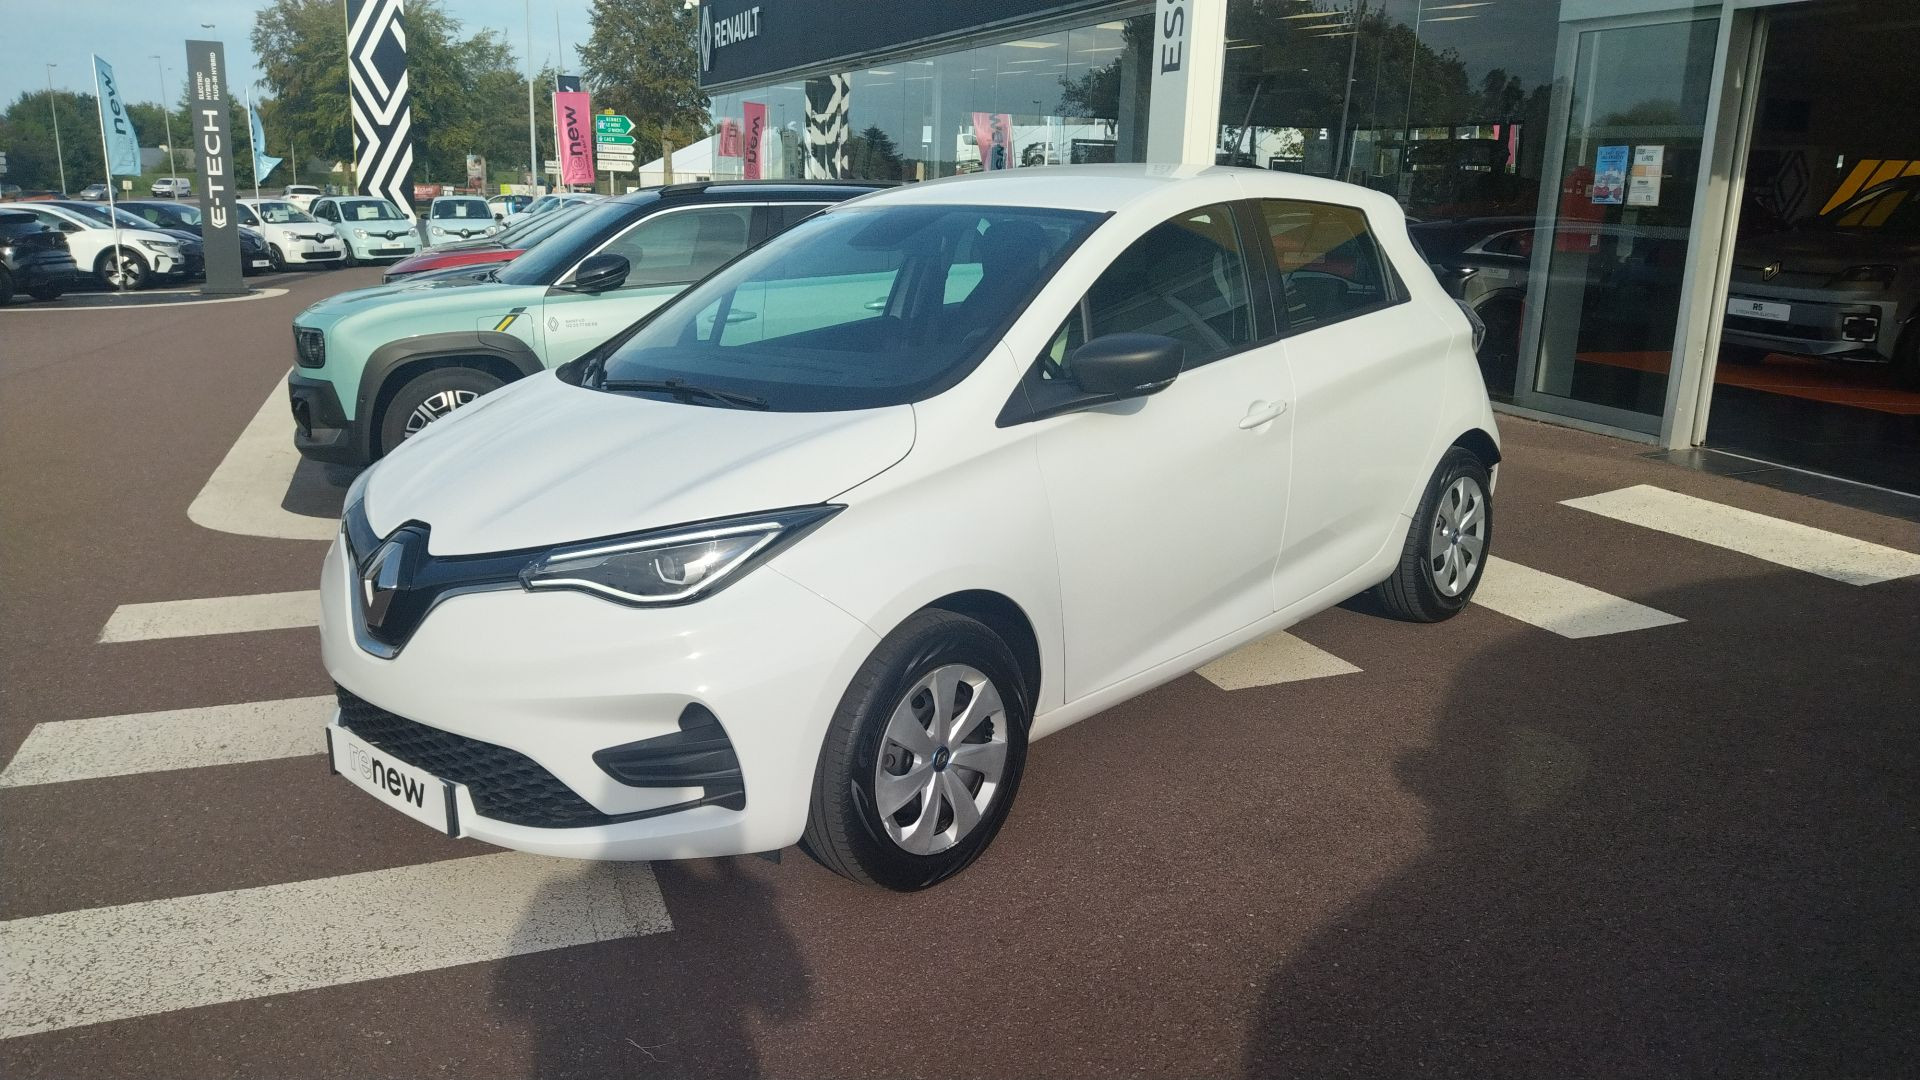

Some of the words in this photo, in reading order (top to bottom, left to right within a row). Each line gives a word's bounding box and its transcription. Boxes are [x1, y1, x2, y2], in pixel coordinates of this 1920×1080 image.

[714, 6, 760, 49] RENAULT
[1161, 0, 1185, 76] ES
[209, 51, 218, 75] HYBRID
[196, 71, 205, 100] ELECTRIC
[204, 77, 212, 101] HYBRID
[212, 75, 220, 101] PLUG-IN
[202, 110, 227, 229] E-TECH
